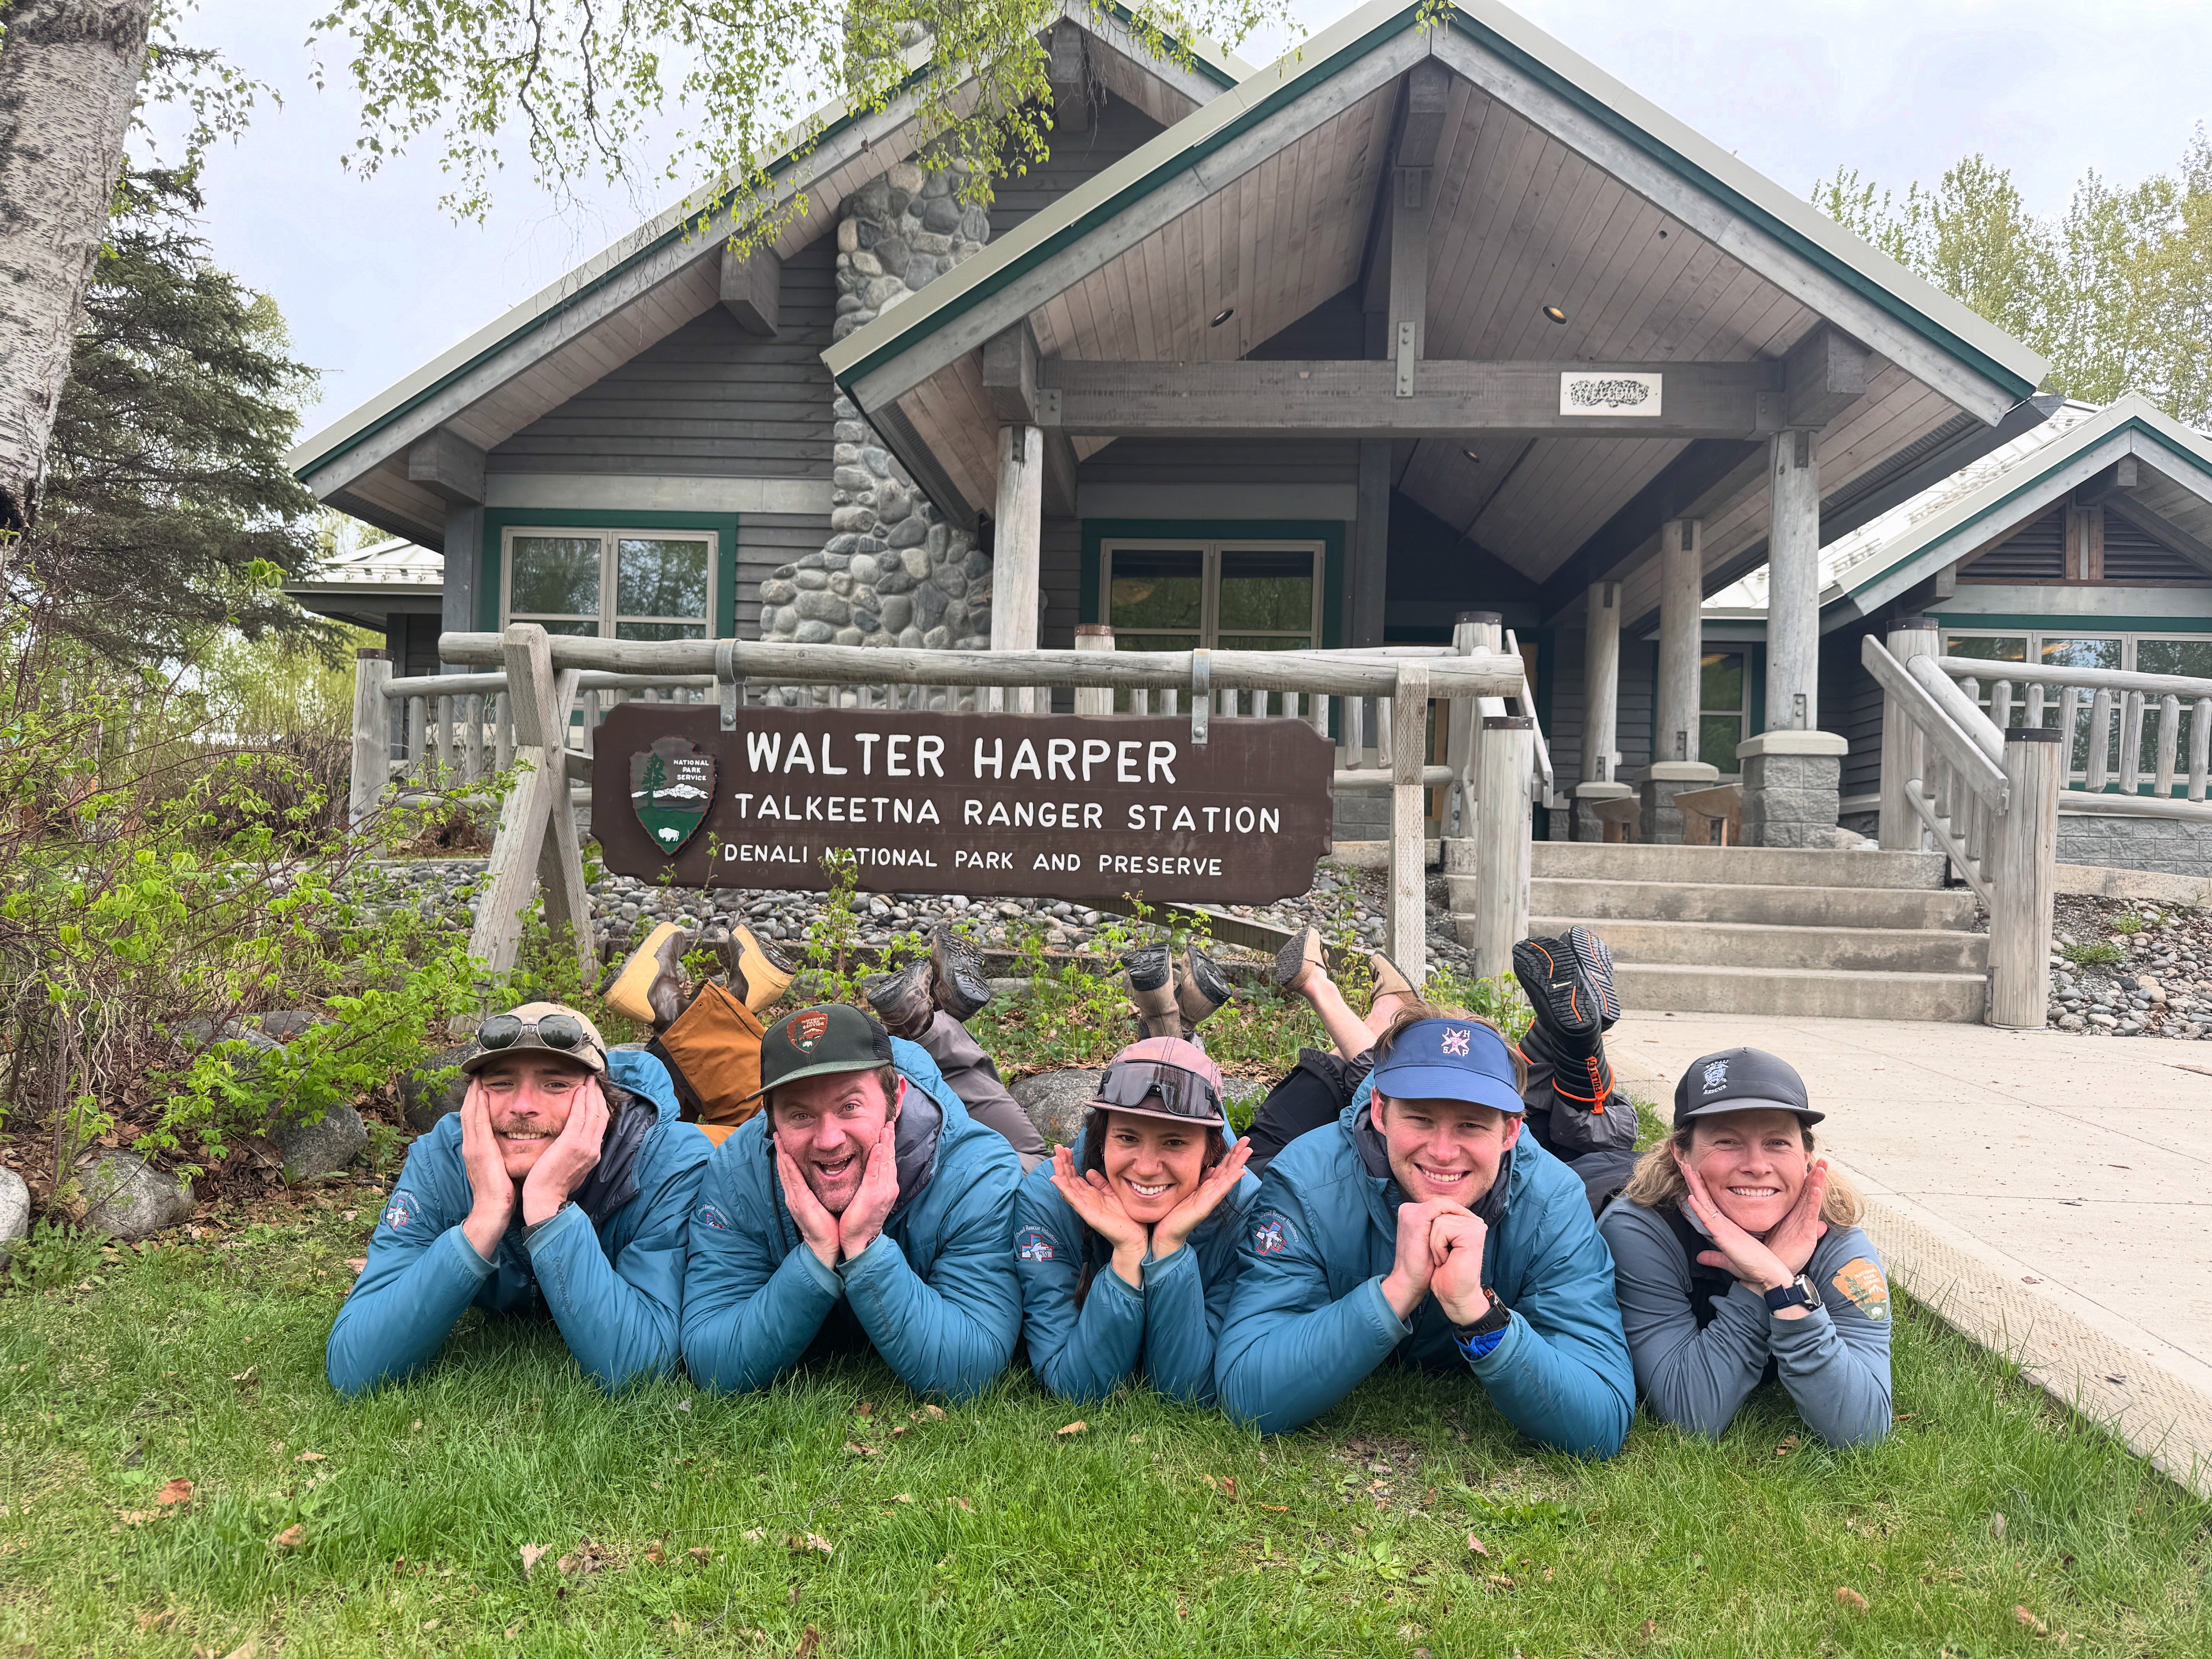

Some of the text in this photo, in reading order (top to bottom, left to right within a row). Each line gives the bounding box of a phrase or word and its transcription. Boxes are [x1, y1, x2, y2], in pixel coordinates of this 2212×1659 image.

[747, 731, 1177, 784] WALTER HARPER
[734, 793, 1279, 834] TALKEETNA RANGER STATION
[725, 844, 1222, 876] DENALI NATIONAL PARK AND PRESERVE
[1592, 1074, 1602, 1092] FULL
[1703, 1084, 1727, 1094] RESCUE
[1272, 1210, 1286, 1220] Rescue
[1286, 1218, 1299, 1243] Volunteers
[1854, 1268, 1877, 1278] NATIONAL
[1863, 1278, 1880, 1286] SERVICE
[556, 1264, 571, 1317] BLACK DIAMOND
